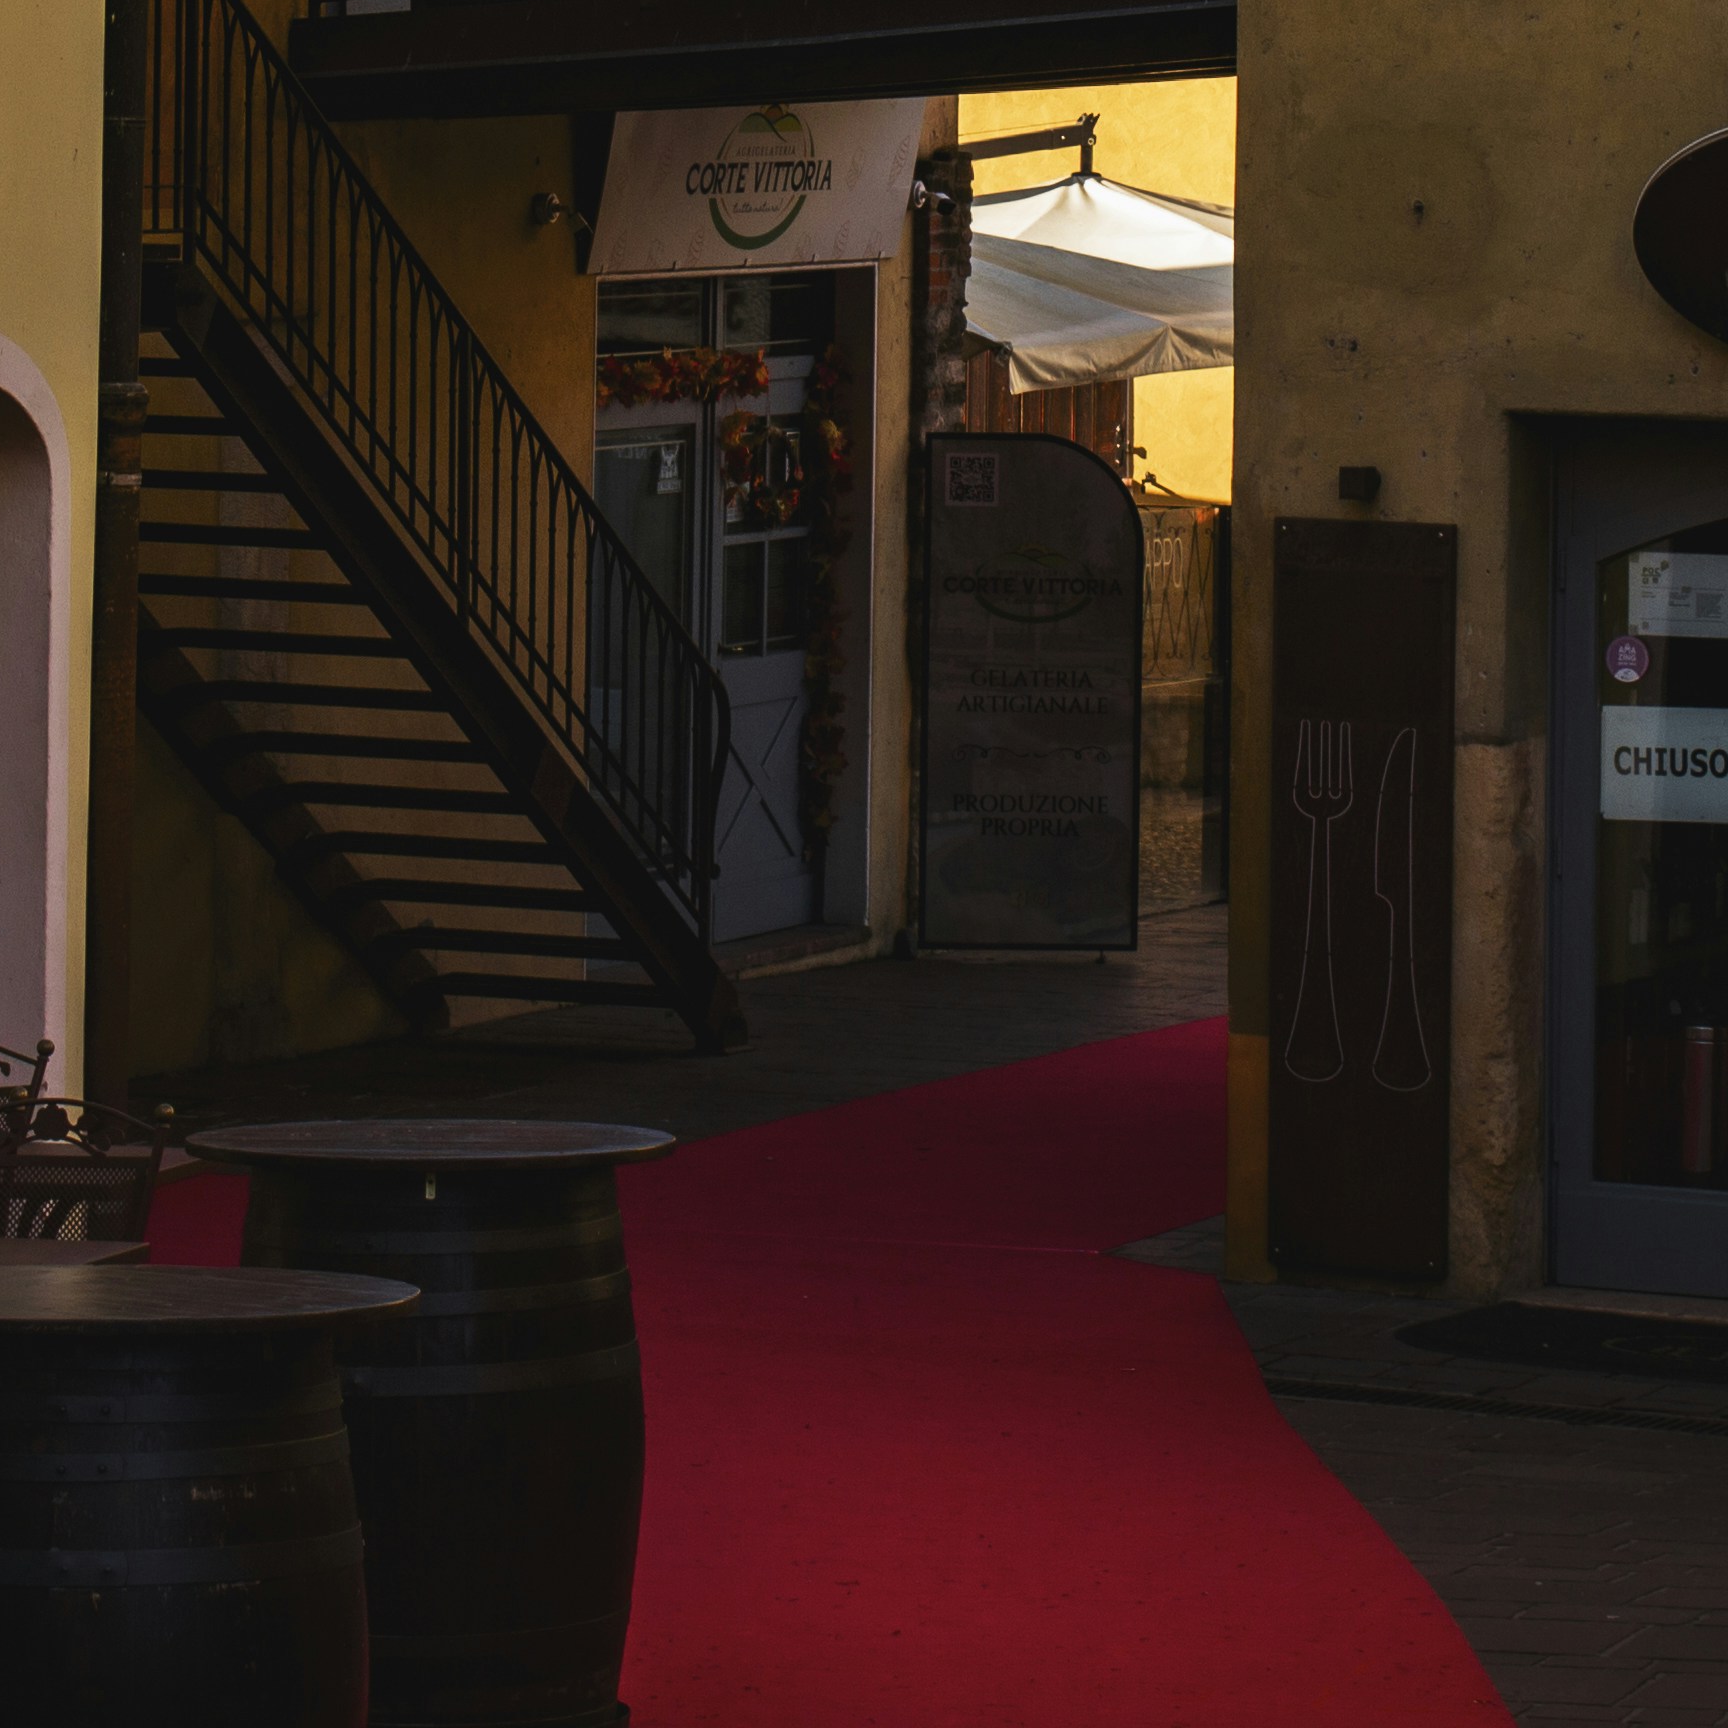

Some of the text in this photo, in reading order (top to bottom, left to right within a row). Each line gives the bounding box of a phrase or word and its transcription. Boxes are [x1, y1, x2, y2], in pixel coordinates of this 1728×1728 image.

[685, 160, 832, 195] CORTE VITTORIA
[943, 576, 1123, 595] CORTE VITTORIA
[970, 670, 1093, 688] GELATERIA
[956, 695, 1109, 714] ARTIGIANALE
[953, 794, 1109, 813] PRODUZIONE
[980, 818, 1080, 837] PROPRIA
